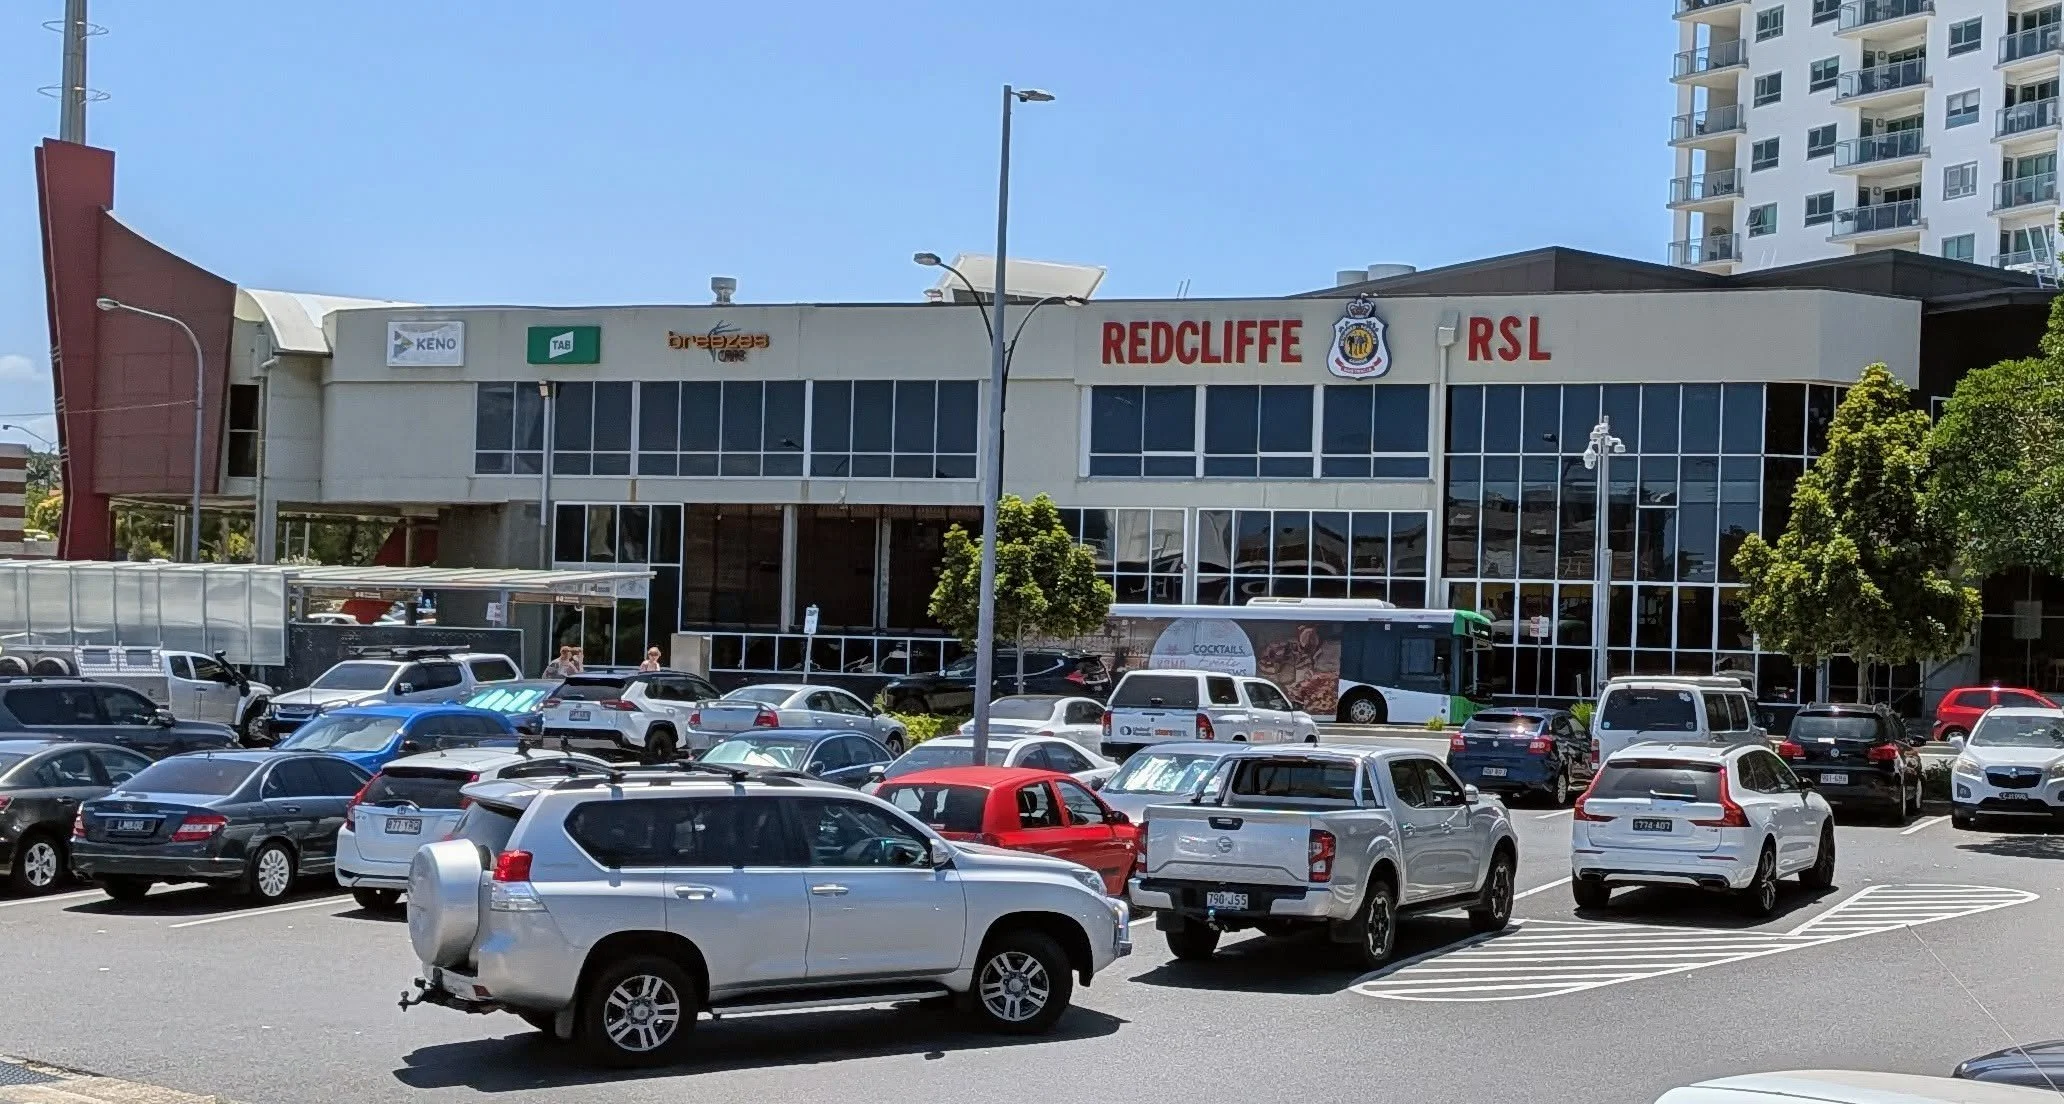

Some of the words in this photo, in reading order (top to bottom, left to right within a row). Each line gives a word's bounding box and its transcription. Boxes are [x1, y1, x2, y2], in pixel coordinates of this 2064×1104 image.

[416, 337, 457, 350] KENO
[551, 340, 571, 350] TAB
[1102, 319, 1303, 364] REDCLIFFE
[1467, 316, 1552, 361] RSL
